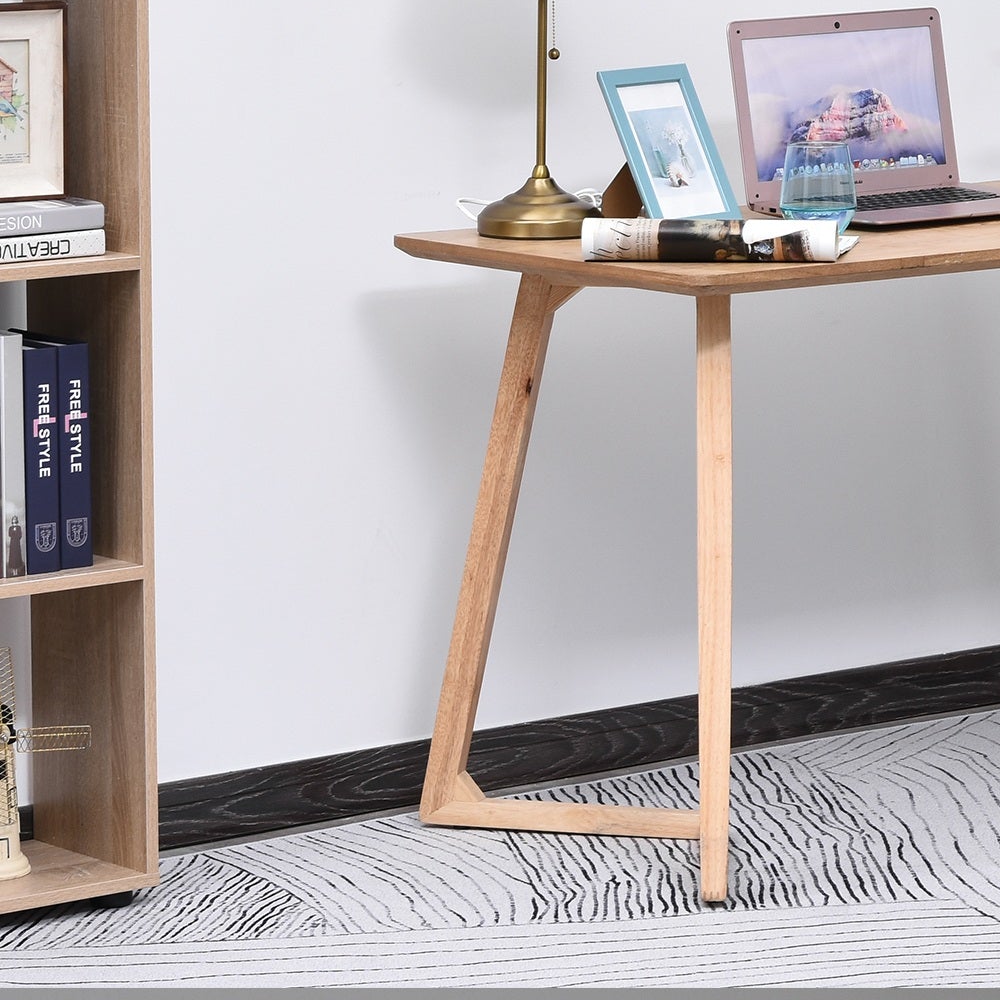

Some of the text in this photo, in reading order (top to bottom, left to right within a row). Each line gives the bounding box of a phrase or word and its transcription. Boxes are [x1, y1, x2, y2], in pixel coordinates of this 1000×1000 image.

[38, 383, 51, 478] FREE STYLE
[69, 379, 82, 474] FREE STYLE
